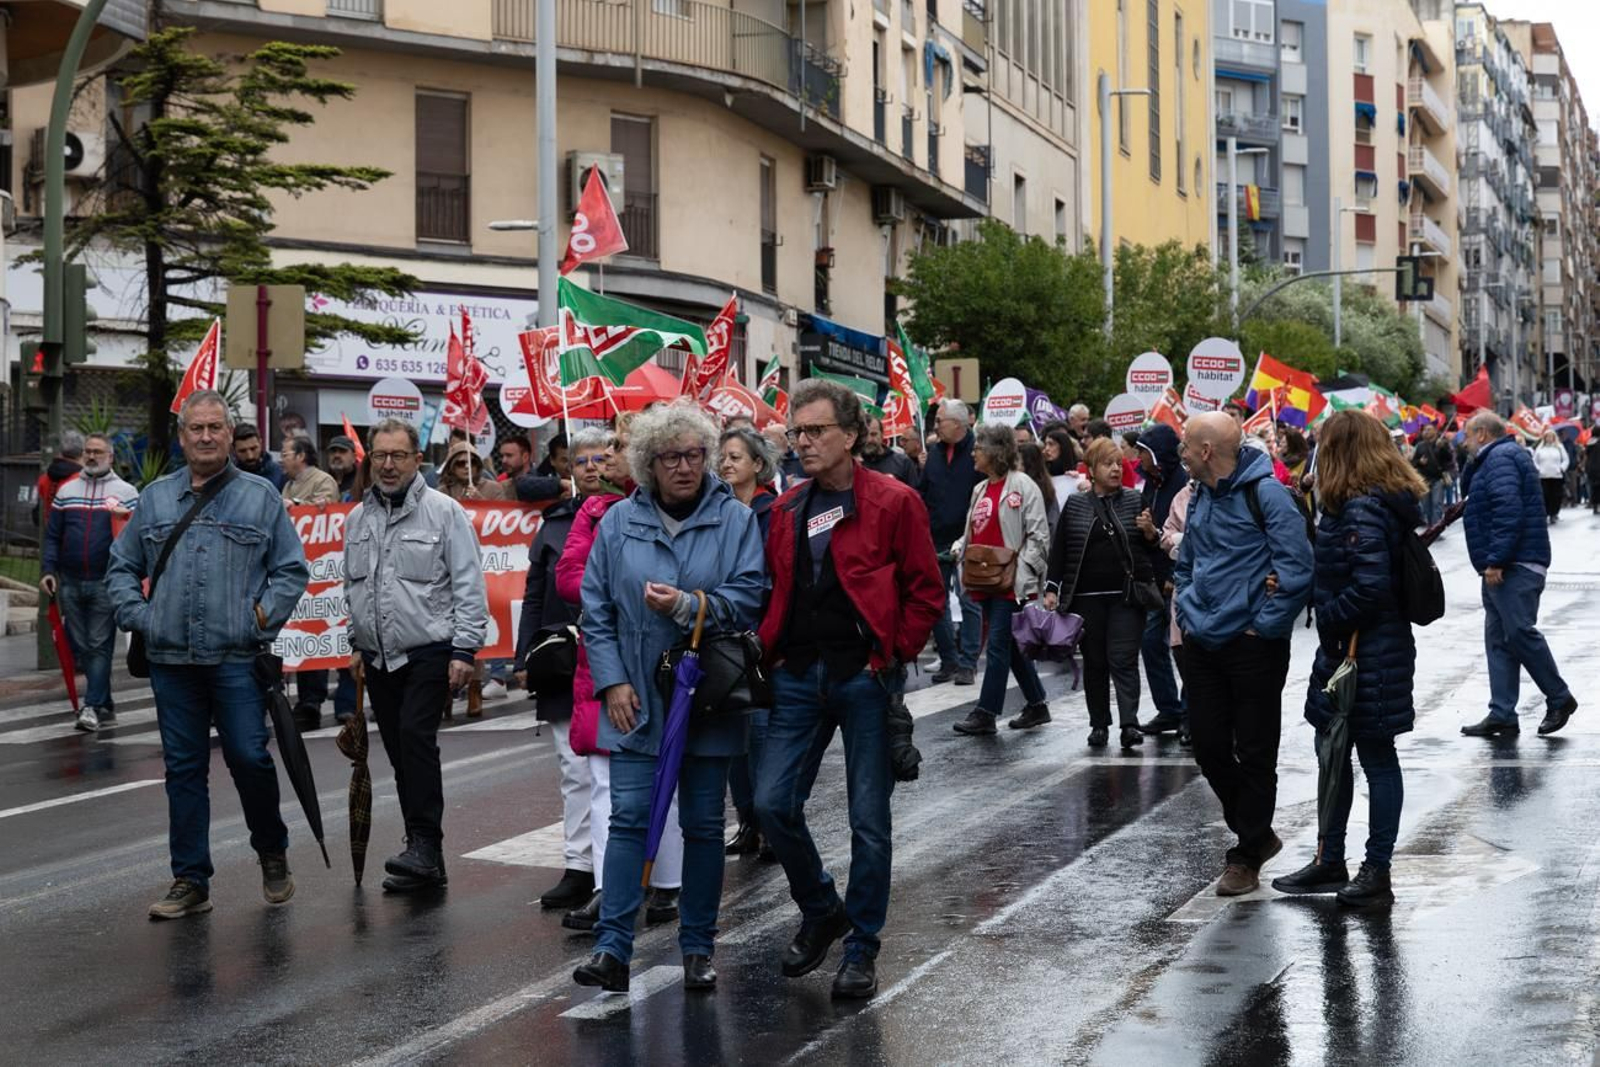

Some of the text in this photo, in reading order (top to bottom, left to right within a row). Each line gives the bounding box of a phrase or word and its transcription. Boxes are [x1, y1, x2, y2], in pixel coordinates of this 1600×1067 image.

[436, 303, 446, 317] &
[852, 348, 865, 366] DEL
[1194, 358, 1226, 369] CCOO
[375, 358, 448, 374] 635 635 126
[1131, 373, 1157, 382] CCOO
[1197, 371, 1234, 382] hábitat
[373, 396, 407, 408] CCOO
[707, 392, 754, 418] UGT
[988, 397, 1012, 408] CCOO
[1108, 414, 1135, 426] CCOO
[290, 512, 345, 545] CAR
[481, 509, 545, 537] DOC
[481, 552, 514, 572] AL
[307, 559, 345, 582] CA
[271, 633, 352, 659] ENOS B
